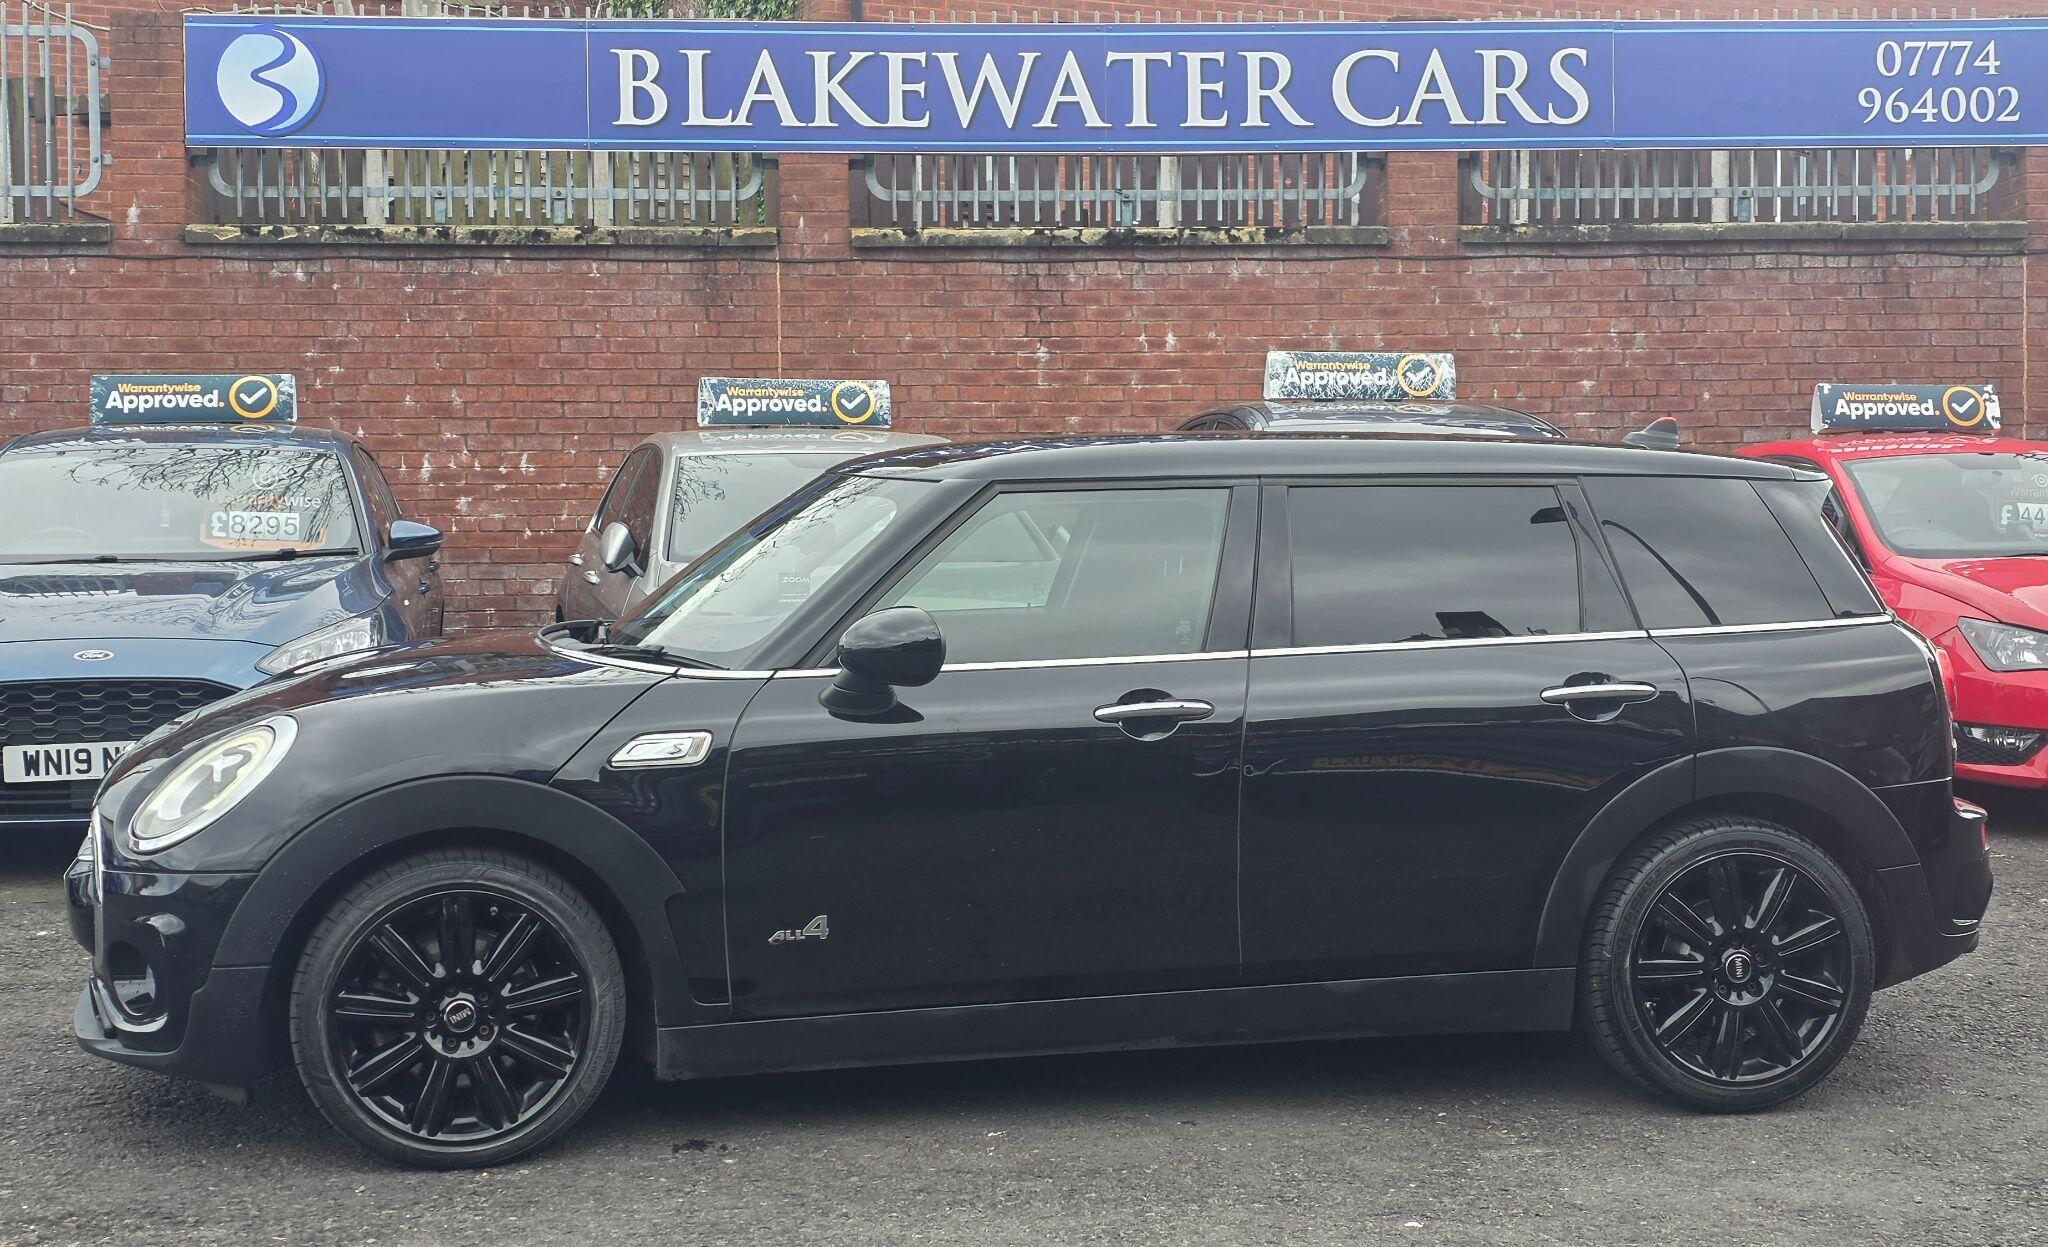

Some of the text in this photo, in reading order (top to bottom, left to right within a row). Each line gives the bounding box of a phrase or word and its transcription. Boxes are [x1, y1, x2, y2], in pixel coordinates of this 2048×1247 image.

[1876, 40, 2001, 77] 07774
[609, 47, 1590, 129] BLAKEWATER CARS
[1858, 86, 2021, 124] 964002
[1295, 360, 1371, 372] Warrantywise
[118, 383, 202, 394] Warrantywise
[726, 386, 805, 398] Warrantywise
[1843, 391, 1917, 402] Warrantywise
[105, 389, 225, 413] Approved.
[716, 394, 828, 416] Approved.
[1835, 398, 1940, 419] Approved.
[210, 511, 299, 537] £8295
[782, 576, 810, 584] ZOOM
[22, 746, 126, 777] WN19 N
[767, 914, 829, 944] ALL4
[1734, 957, 1744, 978] MINI
[448, 1007, 473, 1025] MINI
